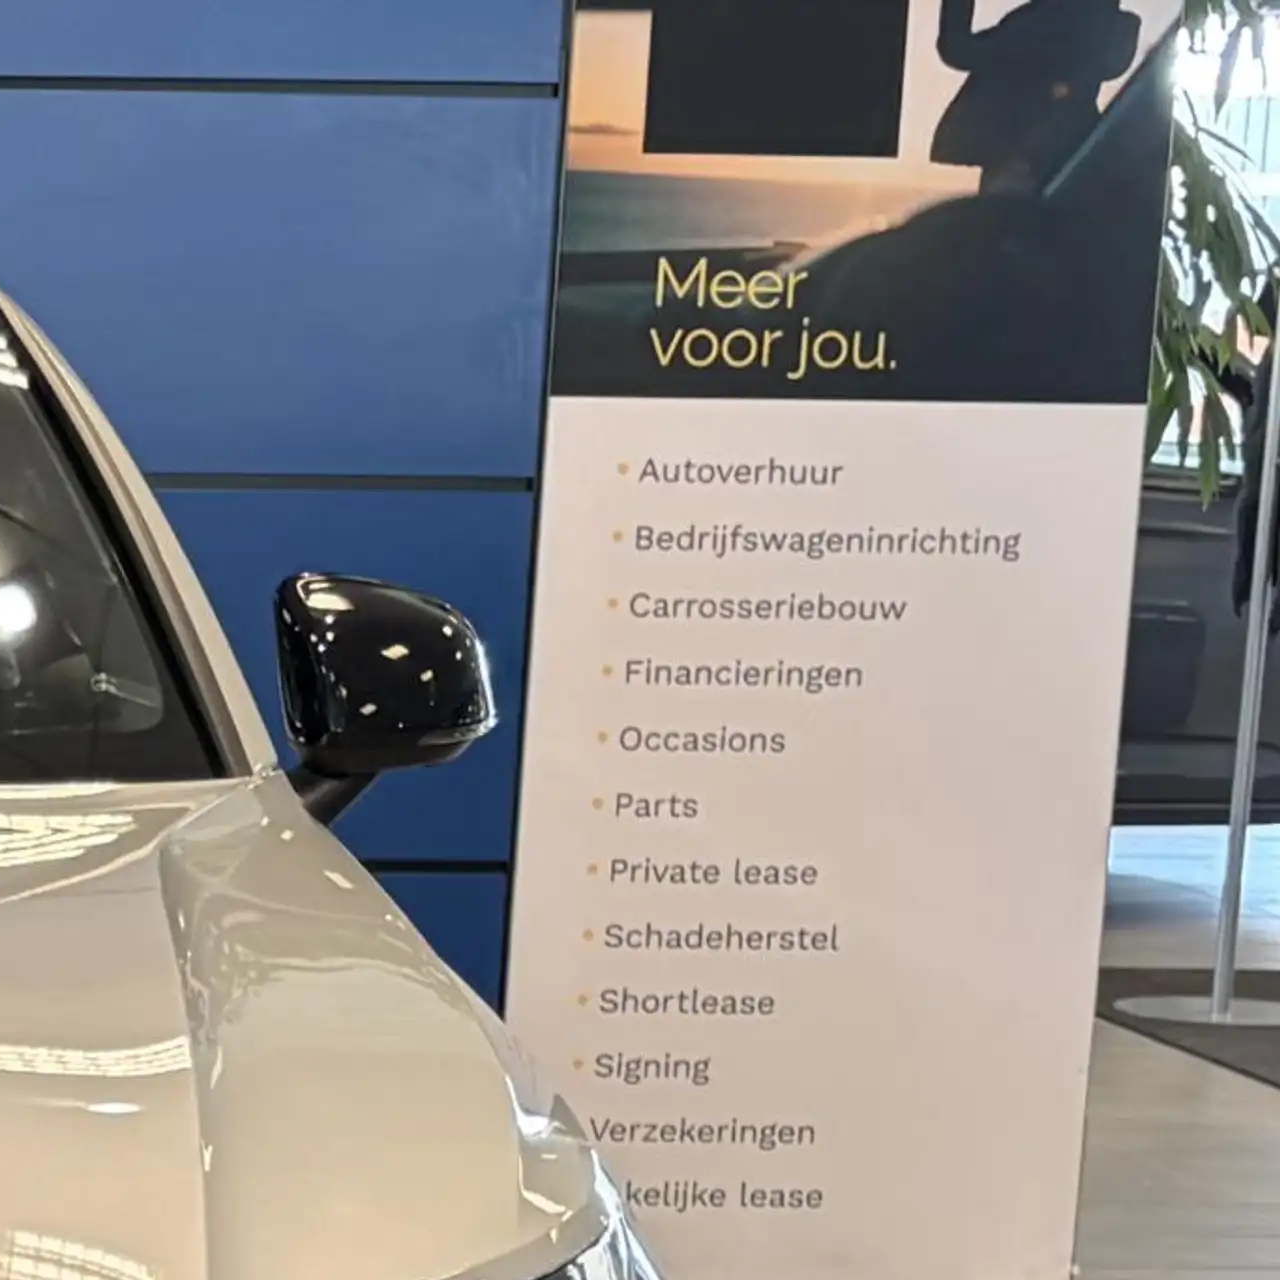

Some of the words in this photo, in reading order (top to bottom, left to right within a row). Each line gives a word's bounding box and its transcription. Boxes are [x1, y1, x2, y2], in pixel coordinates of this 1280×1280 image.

[654, 256, 809, 310] Meer
[650, 327, 783, 369] voor
[787, 316, 897, 380] jou.
[639, 457, 844, 486] Autoverhuur
[634, 524, 1022, 562] Bedrijfswageninrichting
[629, 592, 907, 622] Carrosseriebouw
[625, 658, 864, 694] Financieringen
[619, 725, 786, 754] Occasions
[614, 792, 699, 819] Parts
[609, 857, 721, 886] Private
[734, 858, 819, 886] lease
[603, 922, 839, 952] Schadeherstel
[599, 987, 776, 1016] Shortlease
[593, 1052, 711, 1086] Signing
[589, 1117, 816, 1151] Verzekeringen
[626, 1180, 727, 1214] kelijke
[740, 1181, 824, 1209] lease
